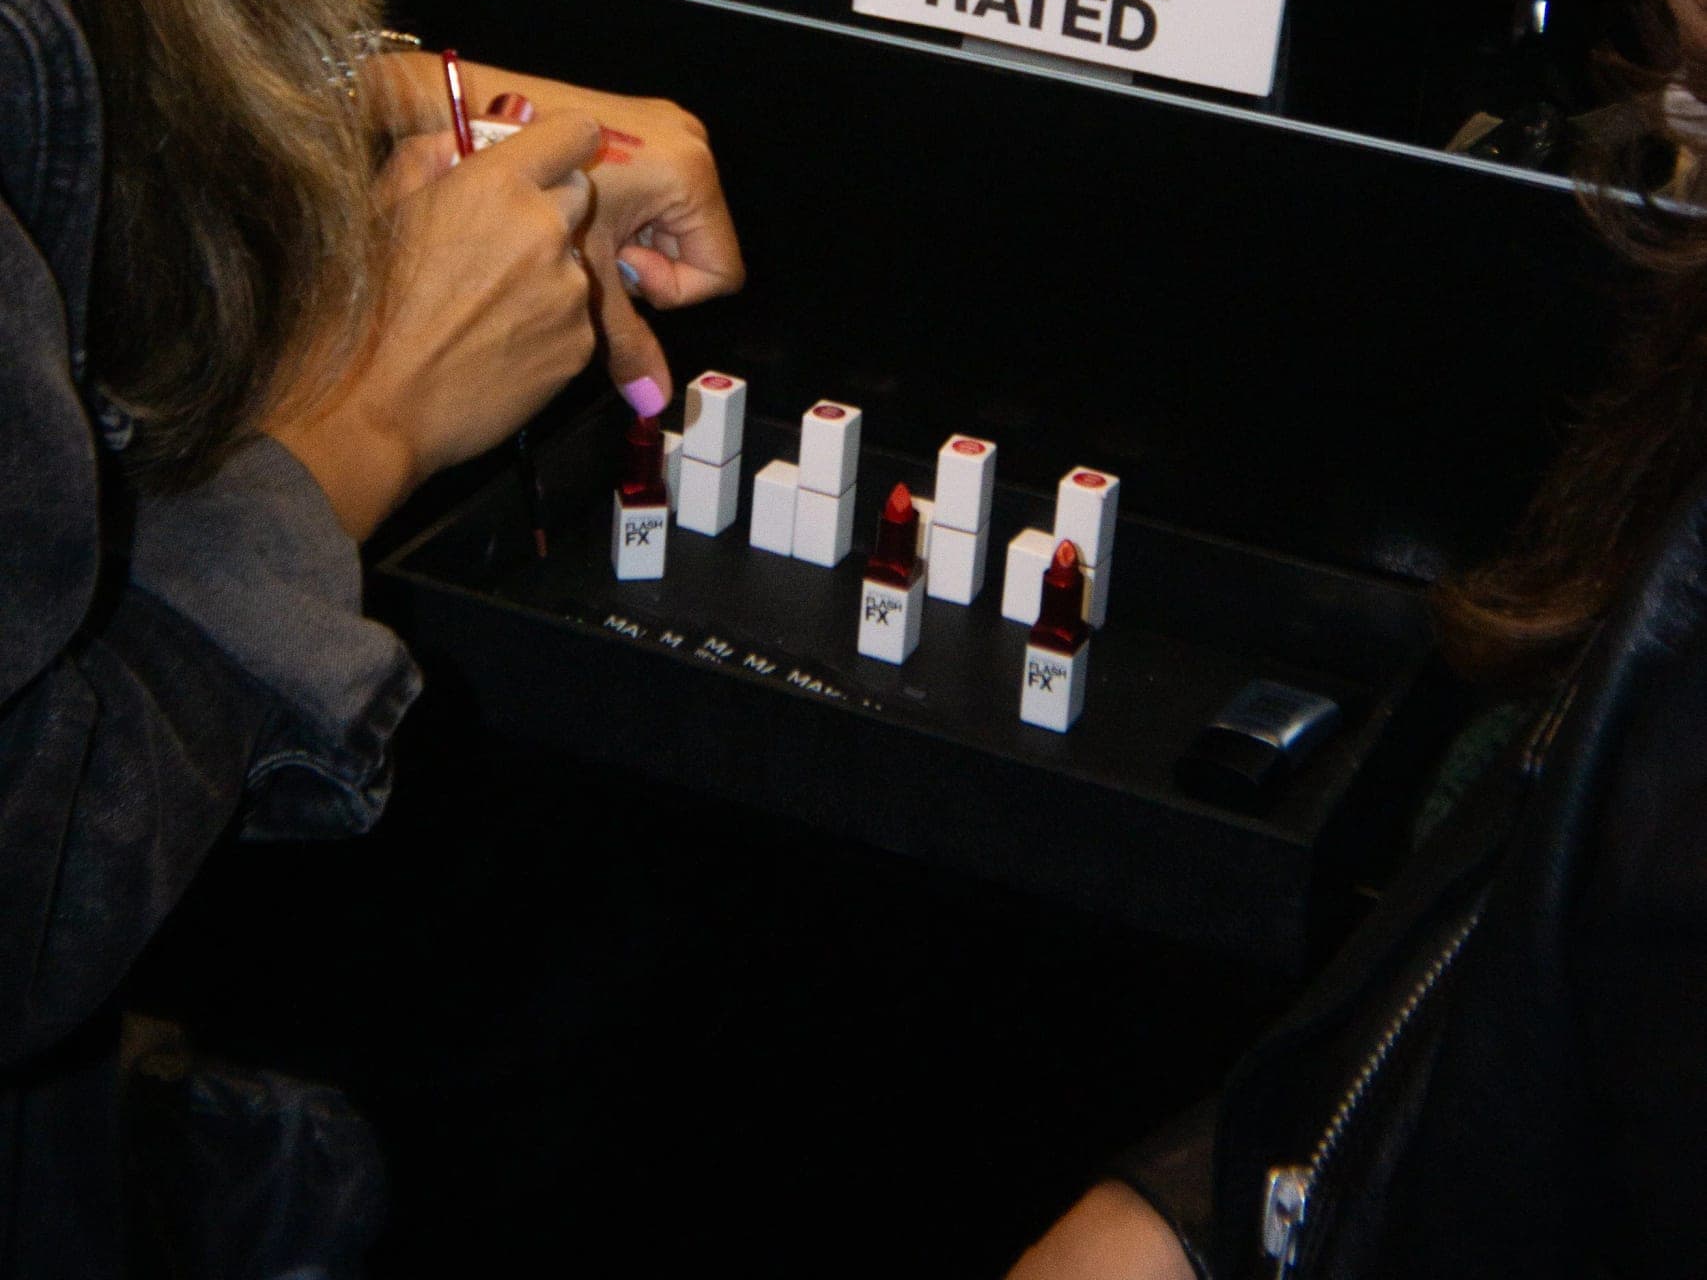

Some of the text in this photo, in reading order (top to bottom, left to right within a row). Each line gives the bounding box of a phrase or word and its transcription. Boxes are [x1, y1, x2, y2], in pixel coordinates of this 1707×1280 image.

[625, 519, 663, 533] FLASH
[625, 531, 650, 547] FX
[866, 596, 903, 613] FLASH
[866, 606, 889, 626] FX
[1028, 661, 1068, 681] FLASH
[1028, 672, 1054, 695] FX
